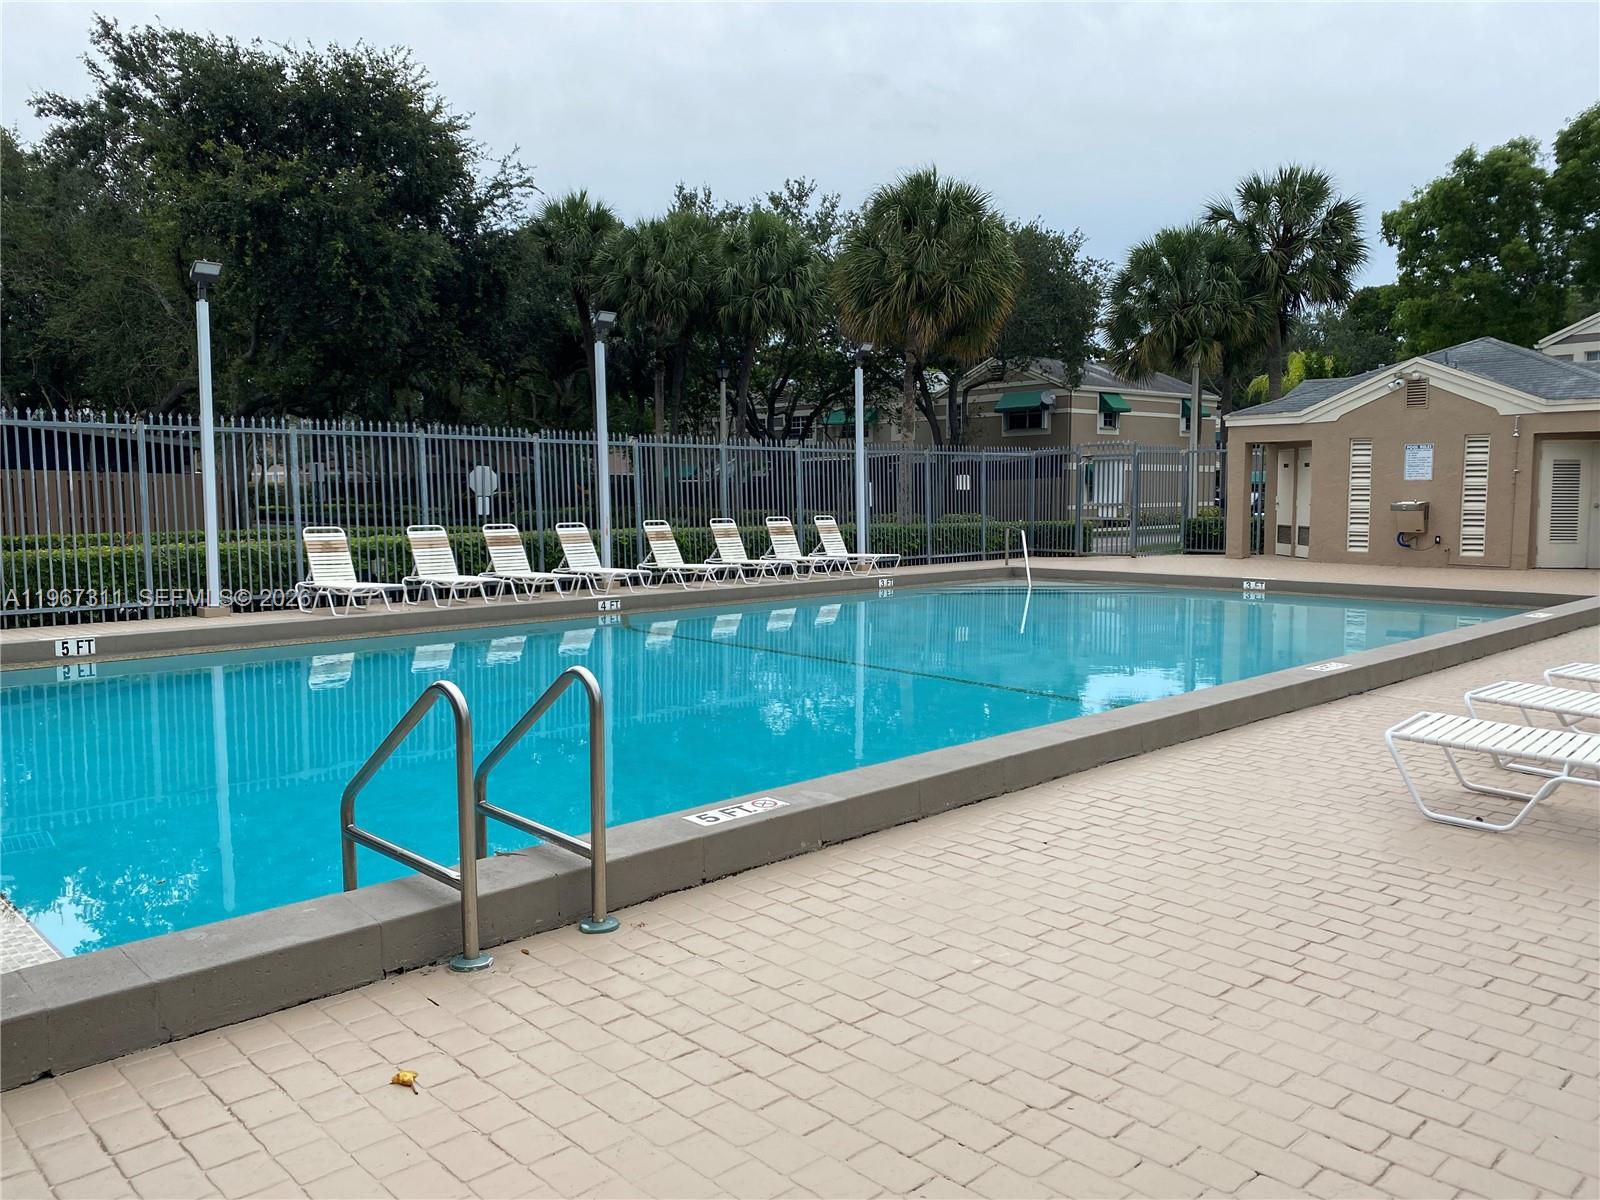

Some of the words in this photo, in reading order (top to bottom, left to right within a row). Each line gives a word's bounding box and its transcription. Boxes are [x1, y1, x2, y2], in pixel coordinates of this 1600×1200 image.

[600, 601, 606, 611] 4
[610, 600, 620, 610] FT
[61, 640, 69, 656] 5
[76, 639, 94, 655] FT
[695, 813, 721, 823] 5
